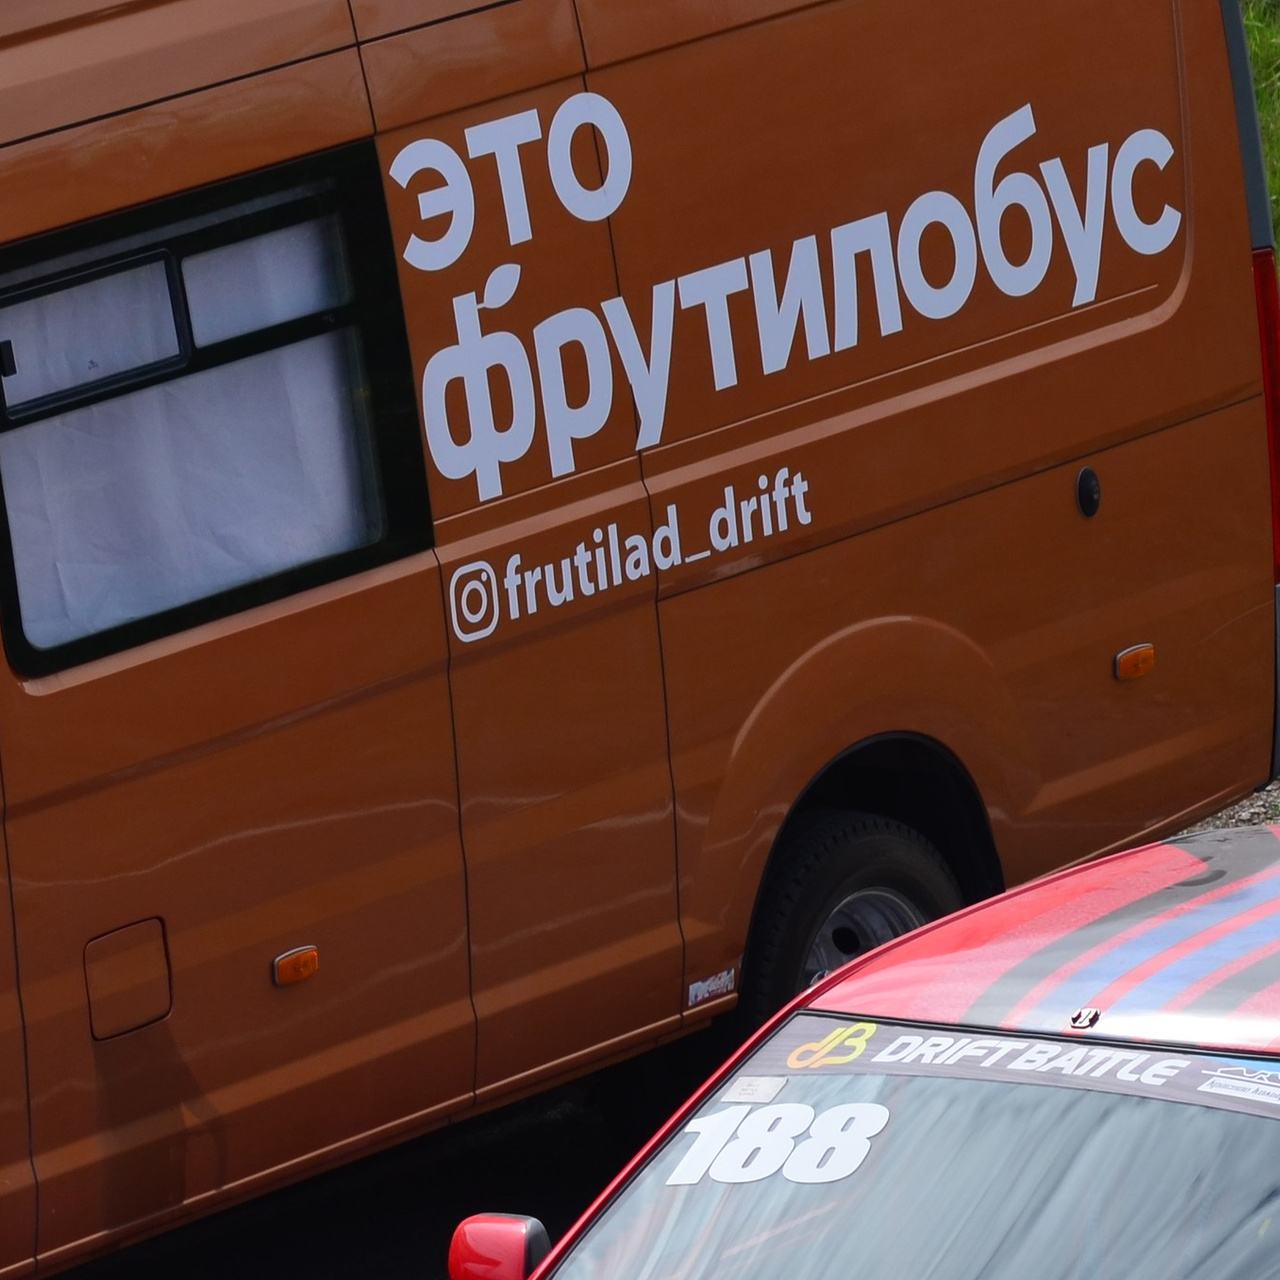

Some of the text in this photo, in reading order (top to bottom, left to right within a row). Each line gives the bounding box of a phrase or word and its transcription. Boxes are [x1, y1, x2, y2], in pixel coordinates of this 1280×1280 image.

[503, 466, 812, 620] frutilad_drift
[872, 1034, 1025, 1067] DRIFT
[1017, 1042, 1191, 1085] BATTLE
[666, 1103, 890, 1186] 188
